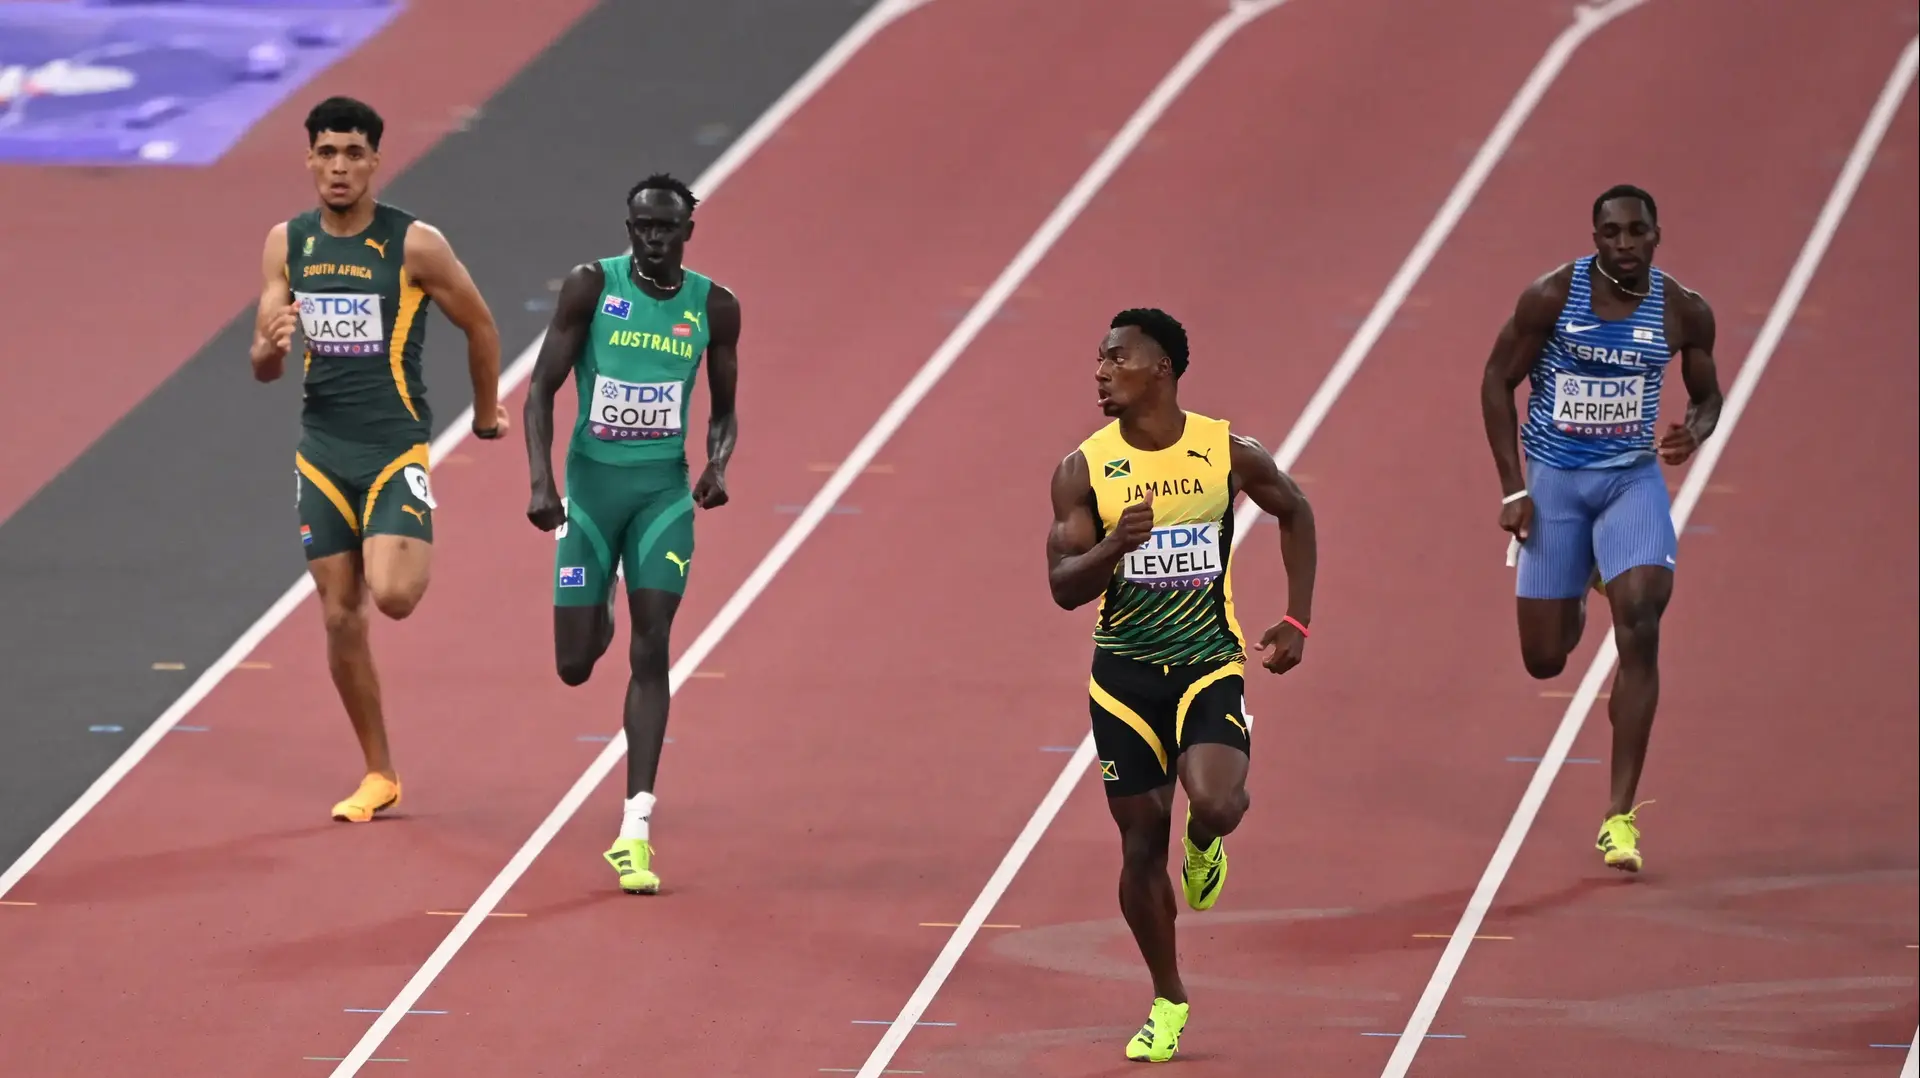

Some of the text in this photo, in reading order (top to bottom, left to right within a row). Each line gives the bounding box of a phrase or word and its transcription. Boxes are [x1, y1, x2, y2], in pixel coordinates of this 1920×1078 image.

[303, 264, 372, 279] SOUTH AFRICA
[315, 298, 372, 316] TDK
[309, 320, 368, 338] JACK
[608, 330, 693, 359] AUSTRALIA
[1564, 341, 1647, 367] ISRAEL
[619, 384, 675, 404] TDK
[1580, 379, 1638, 398] TDK
[602, 405, 672, 427] GOUT
[1560, 401, 1638, 421] AFRIFAH
[1124, 478, 1204, 503] JAMAICA
[1151, 525, 1212, 550] TDK
[1130, 550, 1216, 576] LEVELL
